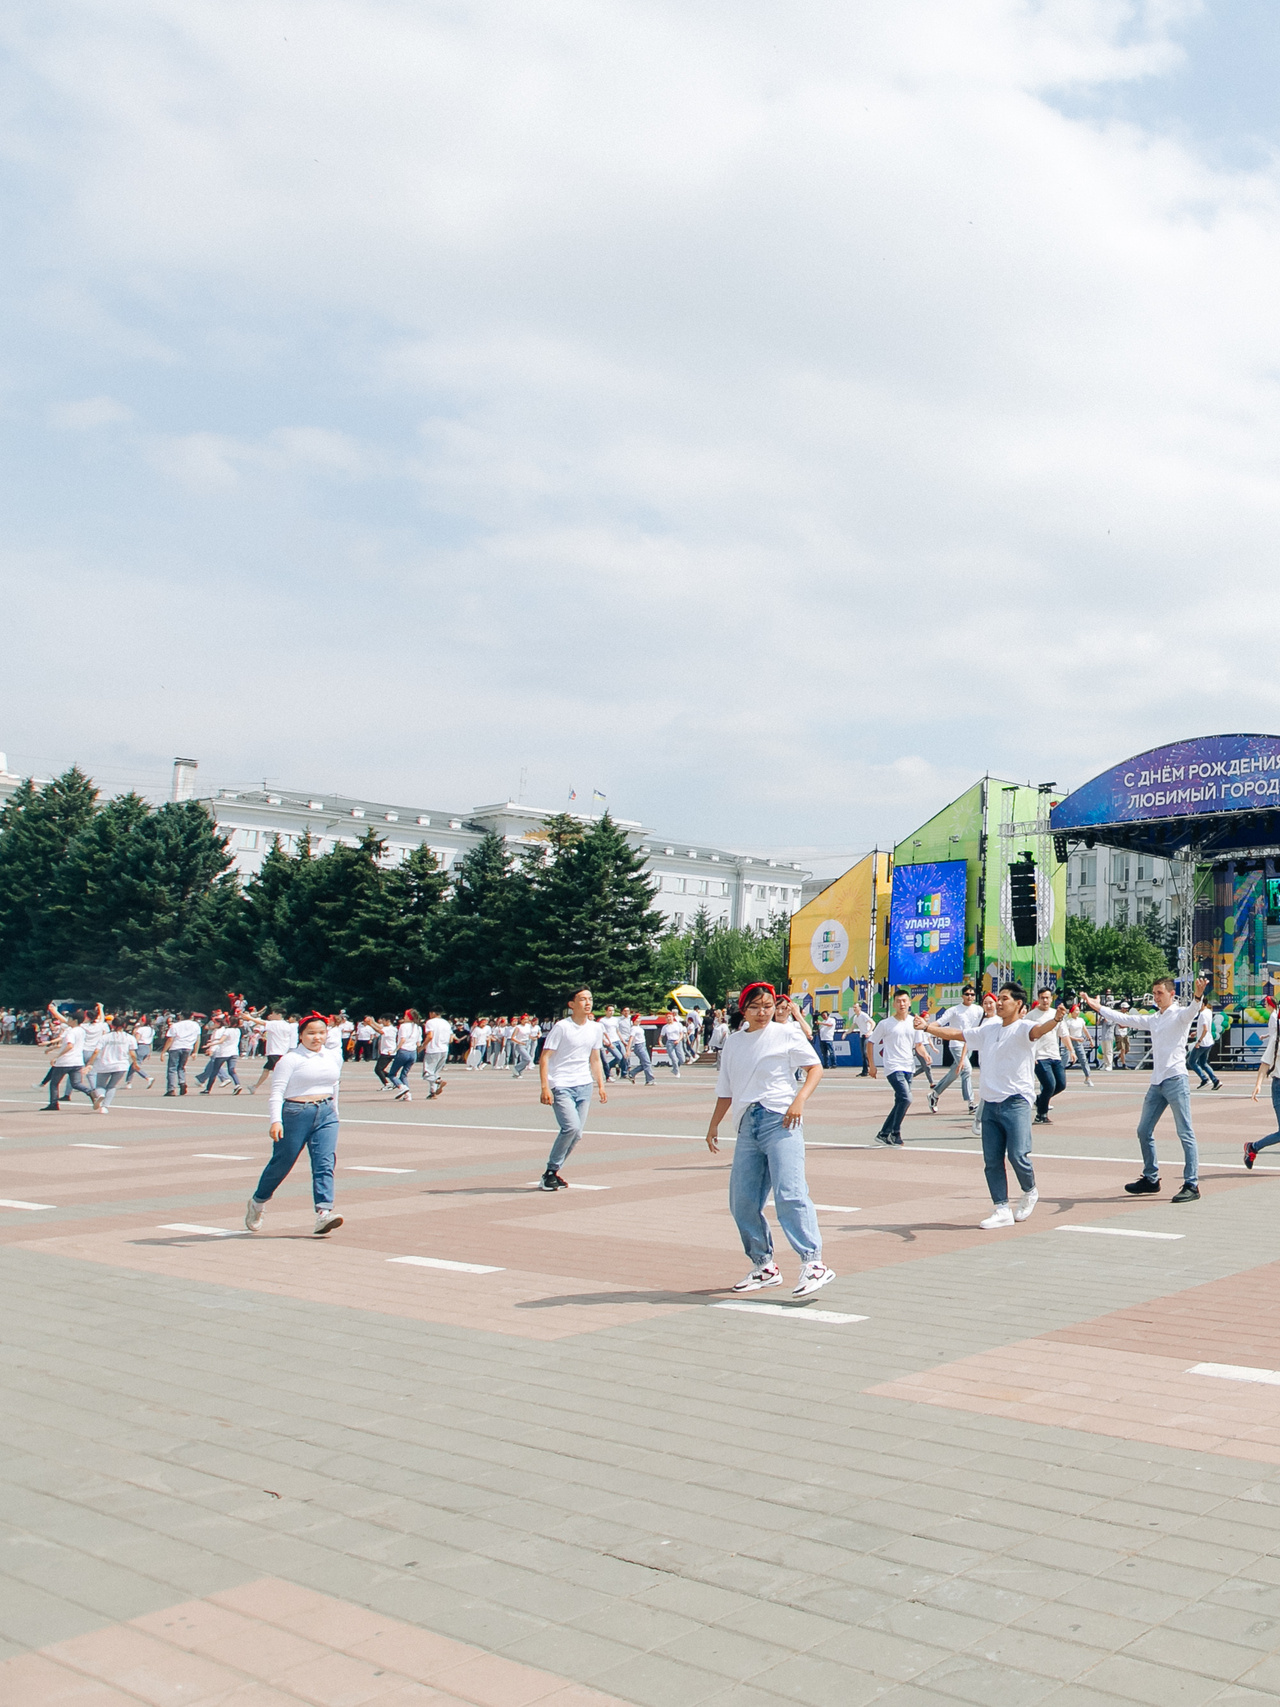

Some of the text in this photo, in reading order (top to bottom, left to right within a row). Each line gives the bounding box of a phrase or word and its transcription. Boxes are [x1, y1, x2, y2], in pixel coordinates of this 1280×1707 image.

[1124, 773, 1135, 787] С
[1138, 766, 1185, 788] ДНЁМ
[1128, 783, 1217, 809] ЛЮБИМЫЙ
[905, 917, 951, 930] УЛАН-УДЭ
